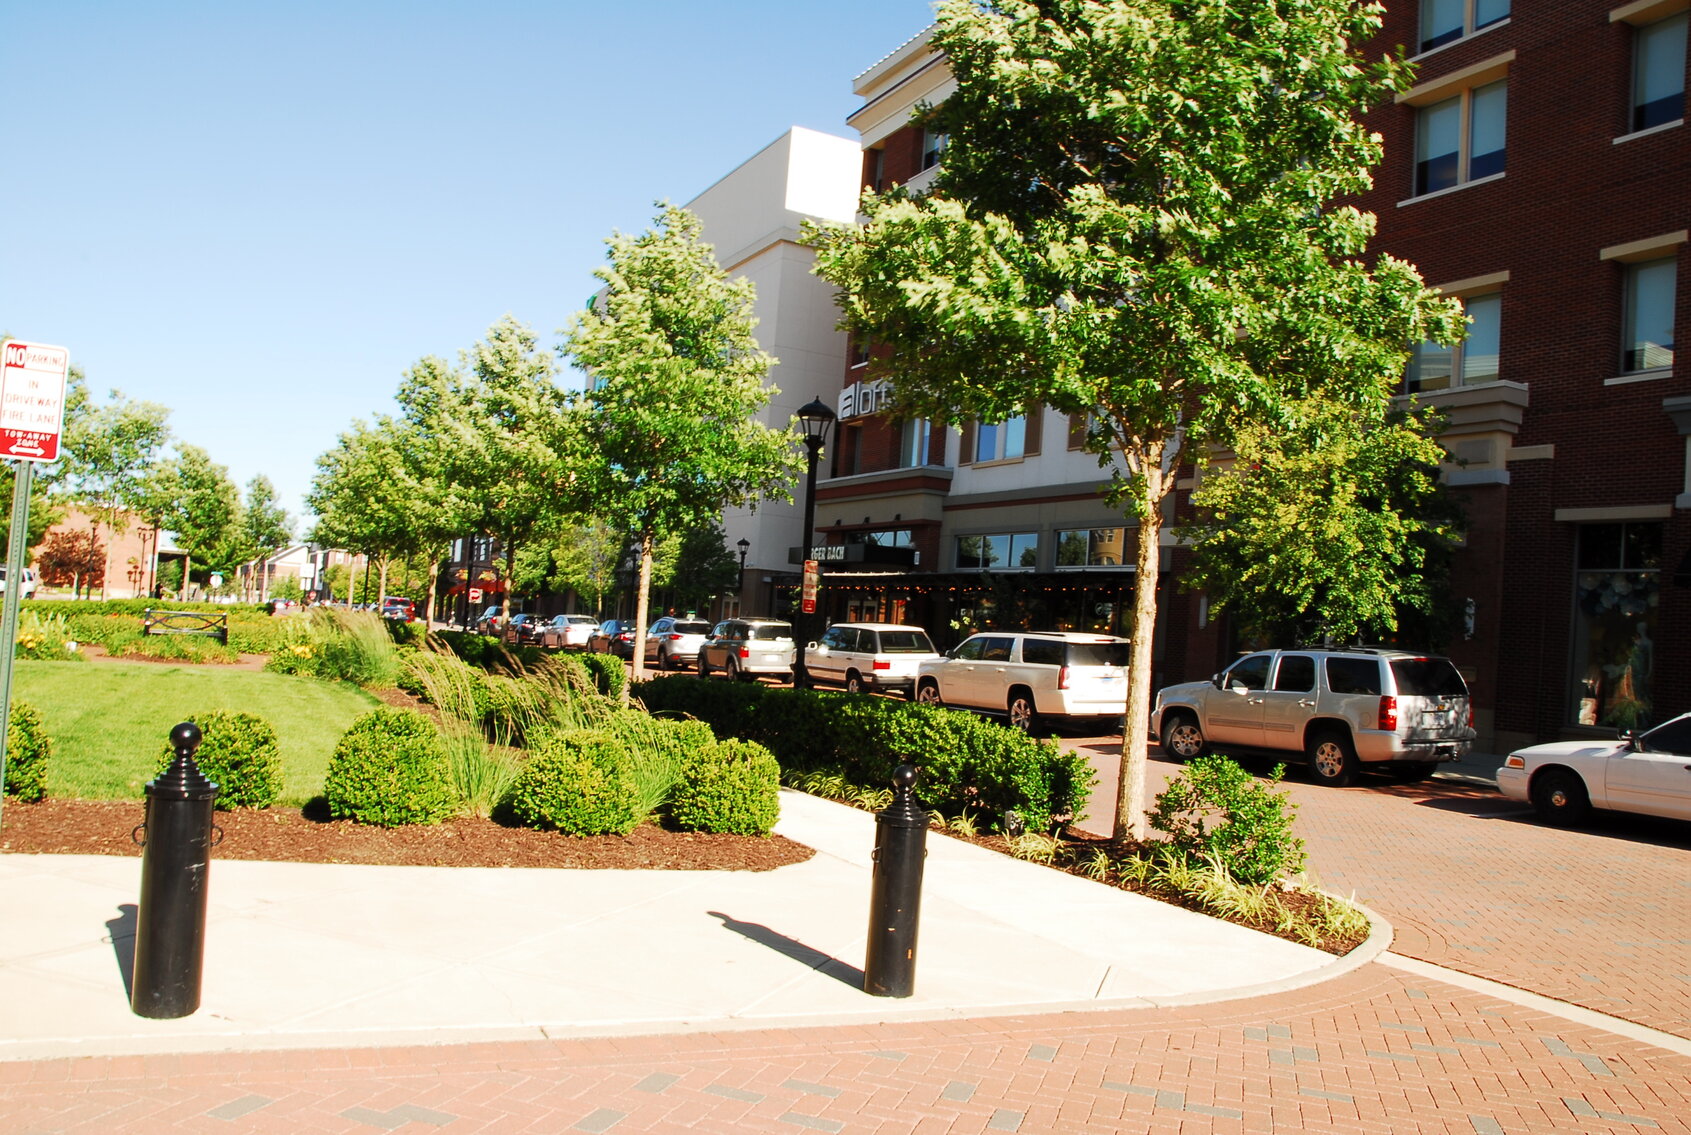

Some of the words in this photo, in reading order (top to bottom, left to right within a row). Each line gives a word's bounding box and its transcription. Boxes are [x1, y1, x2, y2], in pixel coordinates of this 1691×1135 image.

[6, 346, 26, 366] NO
[26, 352, 64, 367] PARKING
[28, 379, 39, 390] IN
[5, 393, 57, 409] DRIVEWAY
[2, 410, 25, 422] FIRE
[29, 413, 56, 425] LANE
[4, 429, 52, 442] TOW-AWAY
[16, 438, 40, 448] ZONE
[827, 546, 845, 560] BACH
